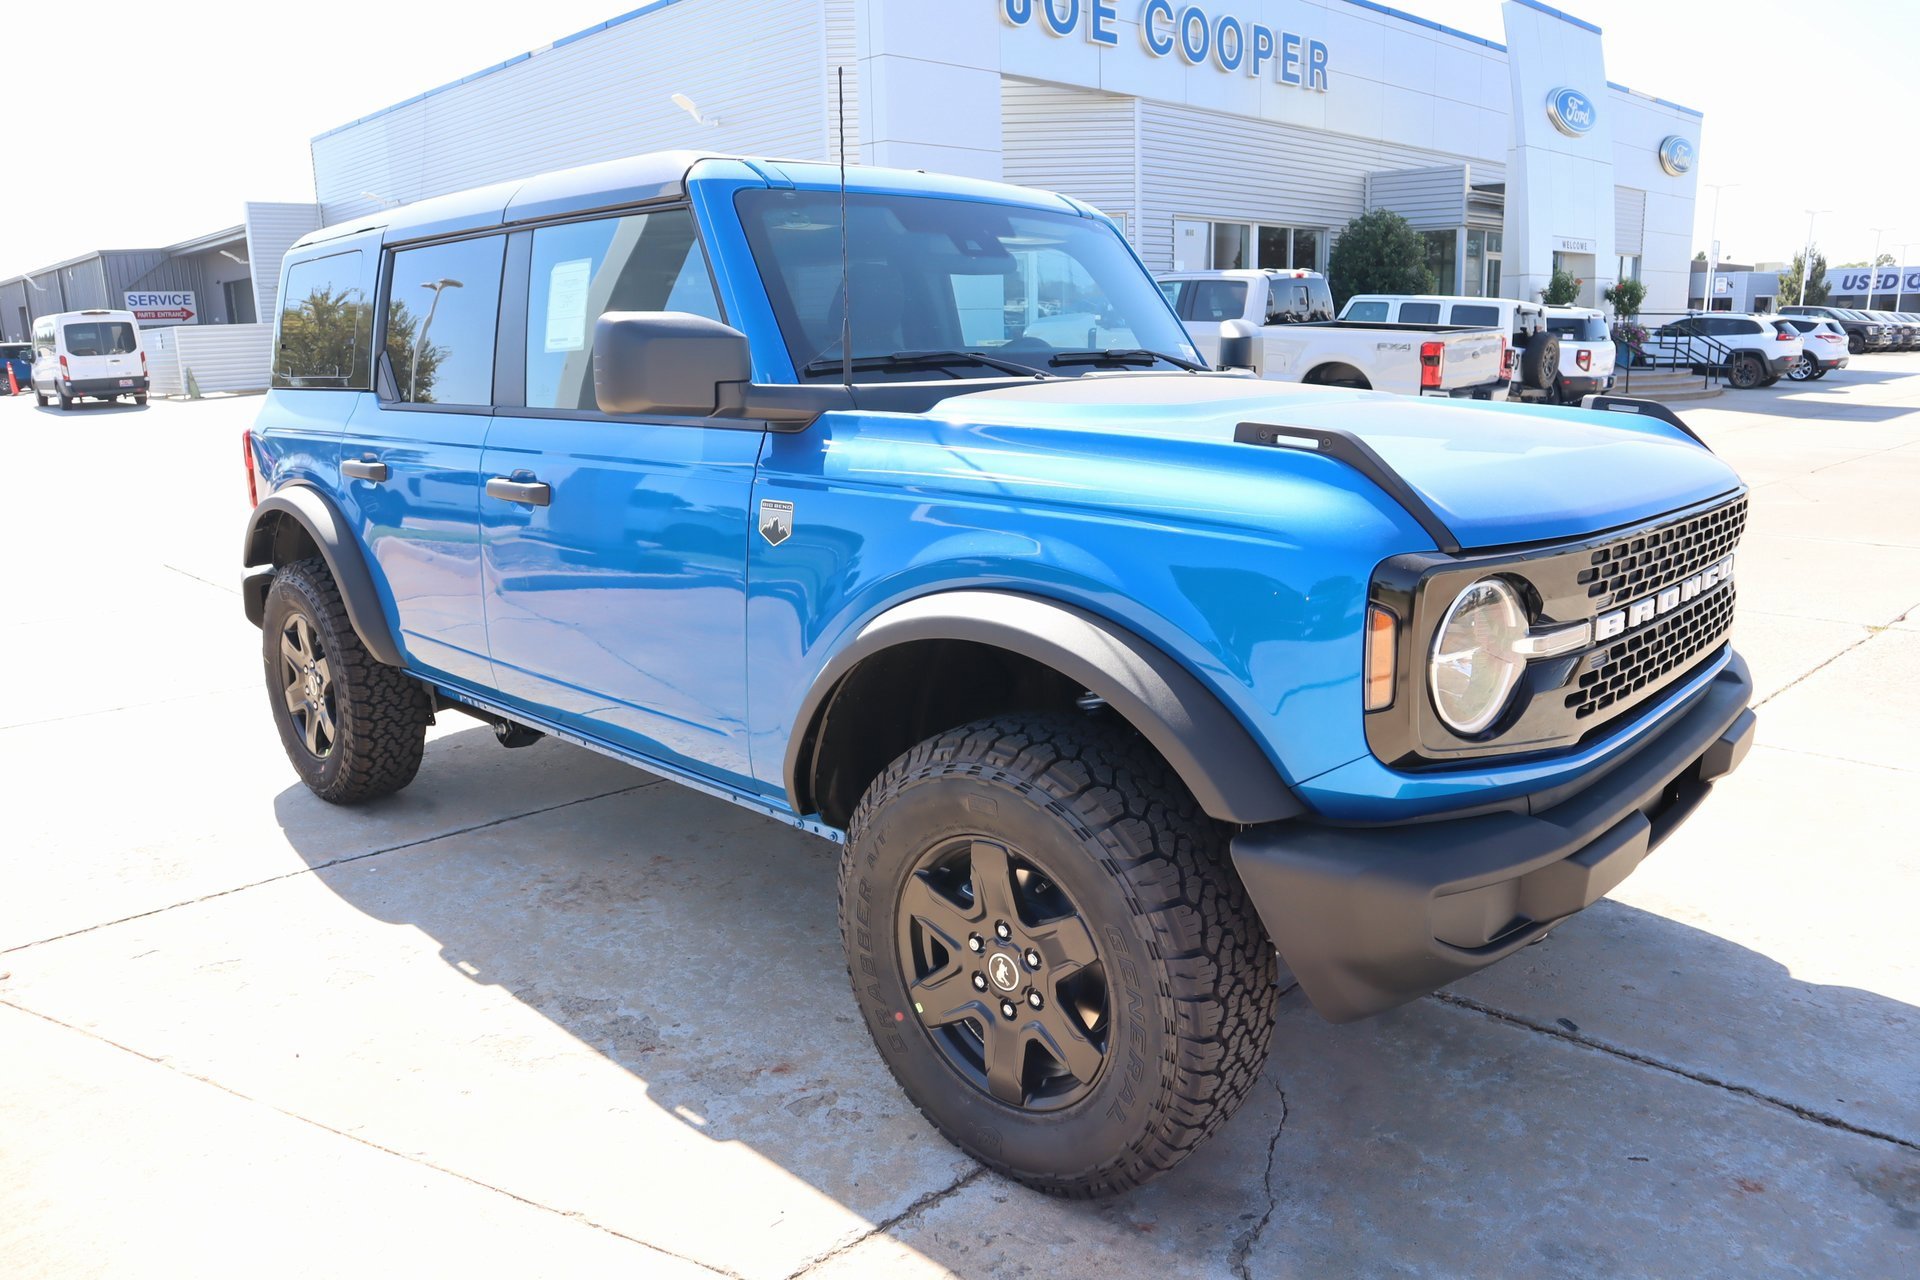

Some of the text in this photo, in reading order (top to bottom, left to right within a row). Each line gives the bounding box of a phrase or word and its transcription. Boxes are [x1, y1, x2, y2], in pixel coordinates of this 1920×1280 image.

[1140, 0, 1329, 93] COOPER
[1566, 96, 1590, 125] Ford
[1674, 144, 1692, 167] Ford
[1562, 240, 1587, 250] WELCOME
[1906, 273, 1920, 289] C
[128, 294, 192, 306] SERVICE
[1596, 554, 1734, 640] BRONCO
[857, 878, 909, 1053] GRABBER
[1105, 924, 1146, 1123] GENERAL
